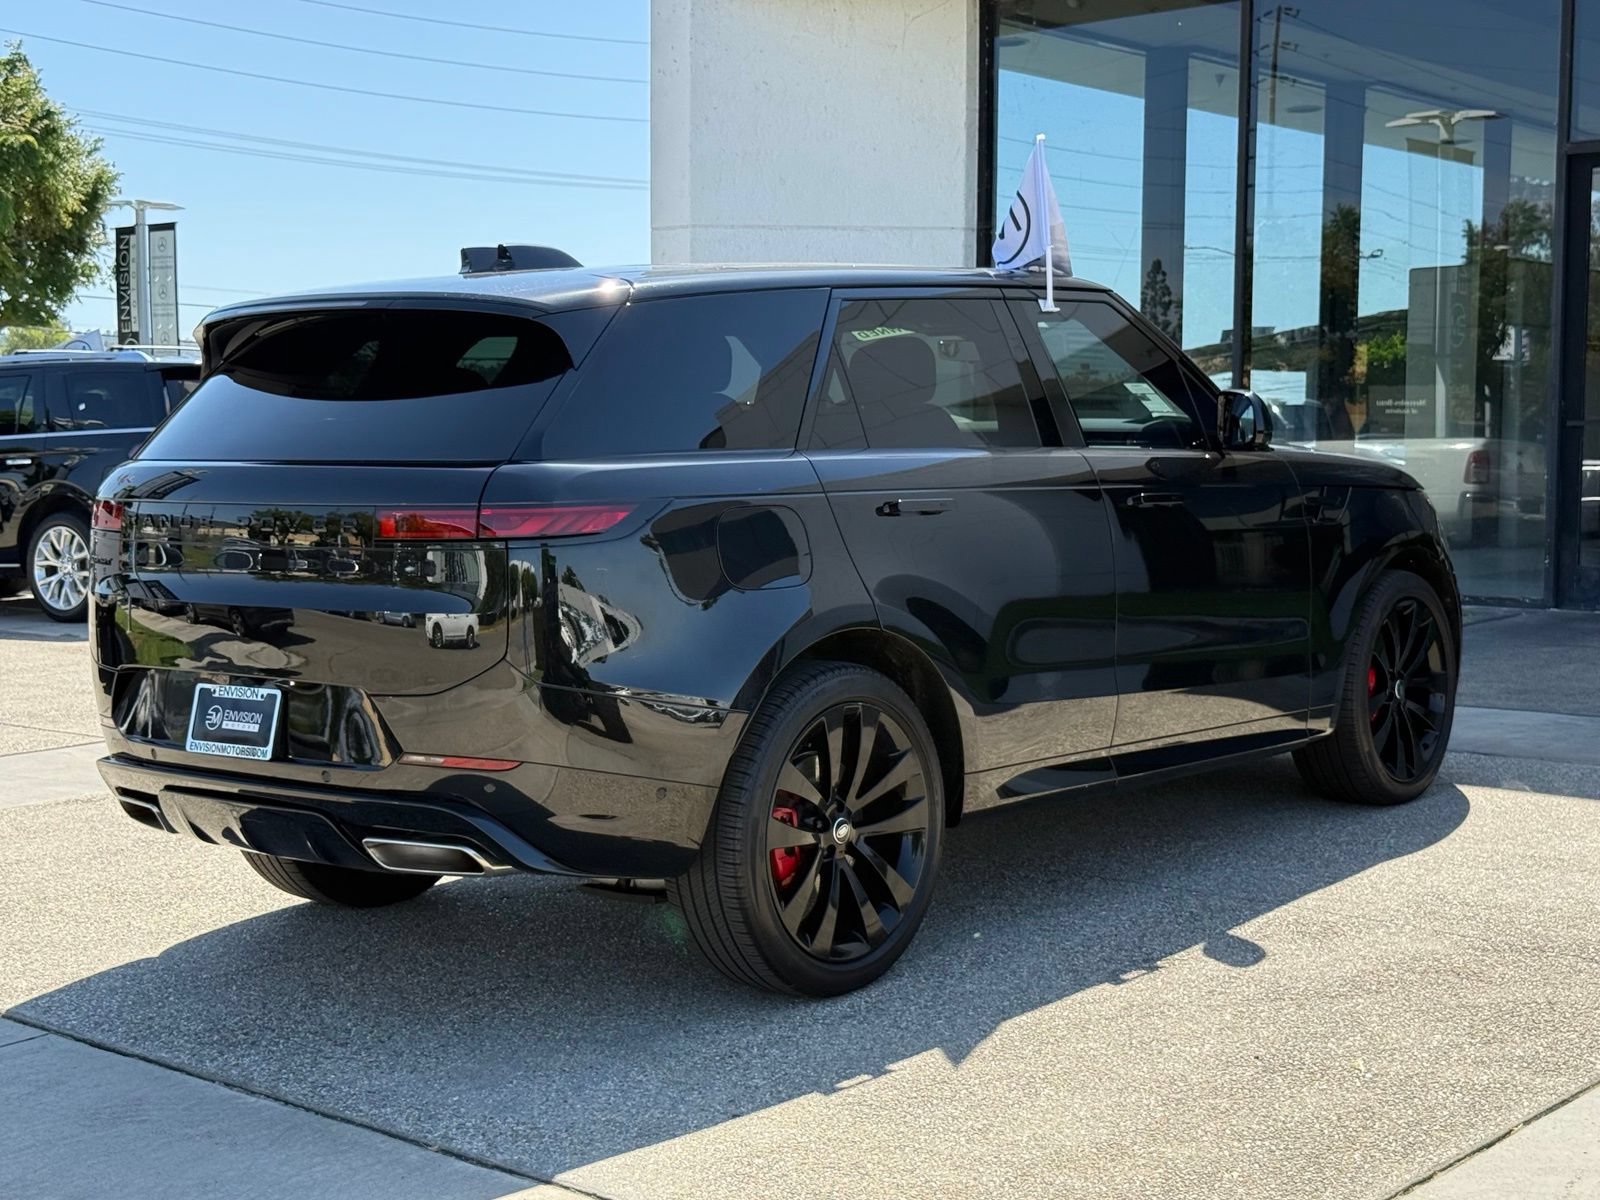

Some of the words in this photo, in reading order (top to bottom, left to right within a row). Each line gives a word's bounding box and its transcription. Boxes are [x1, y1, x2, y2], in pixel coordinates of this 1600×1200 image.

[120, 234, 131, 333] ENVISION
[219, 686, 259, 699] ENVISION
[223, 710, 263, 723] ENVISION
